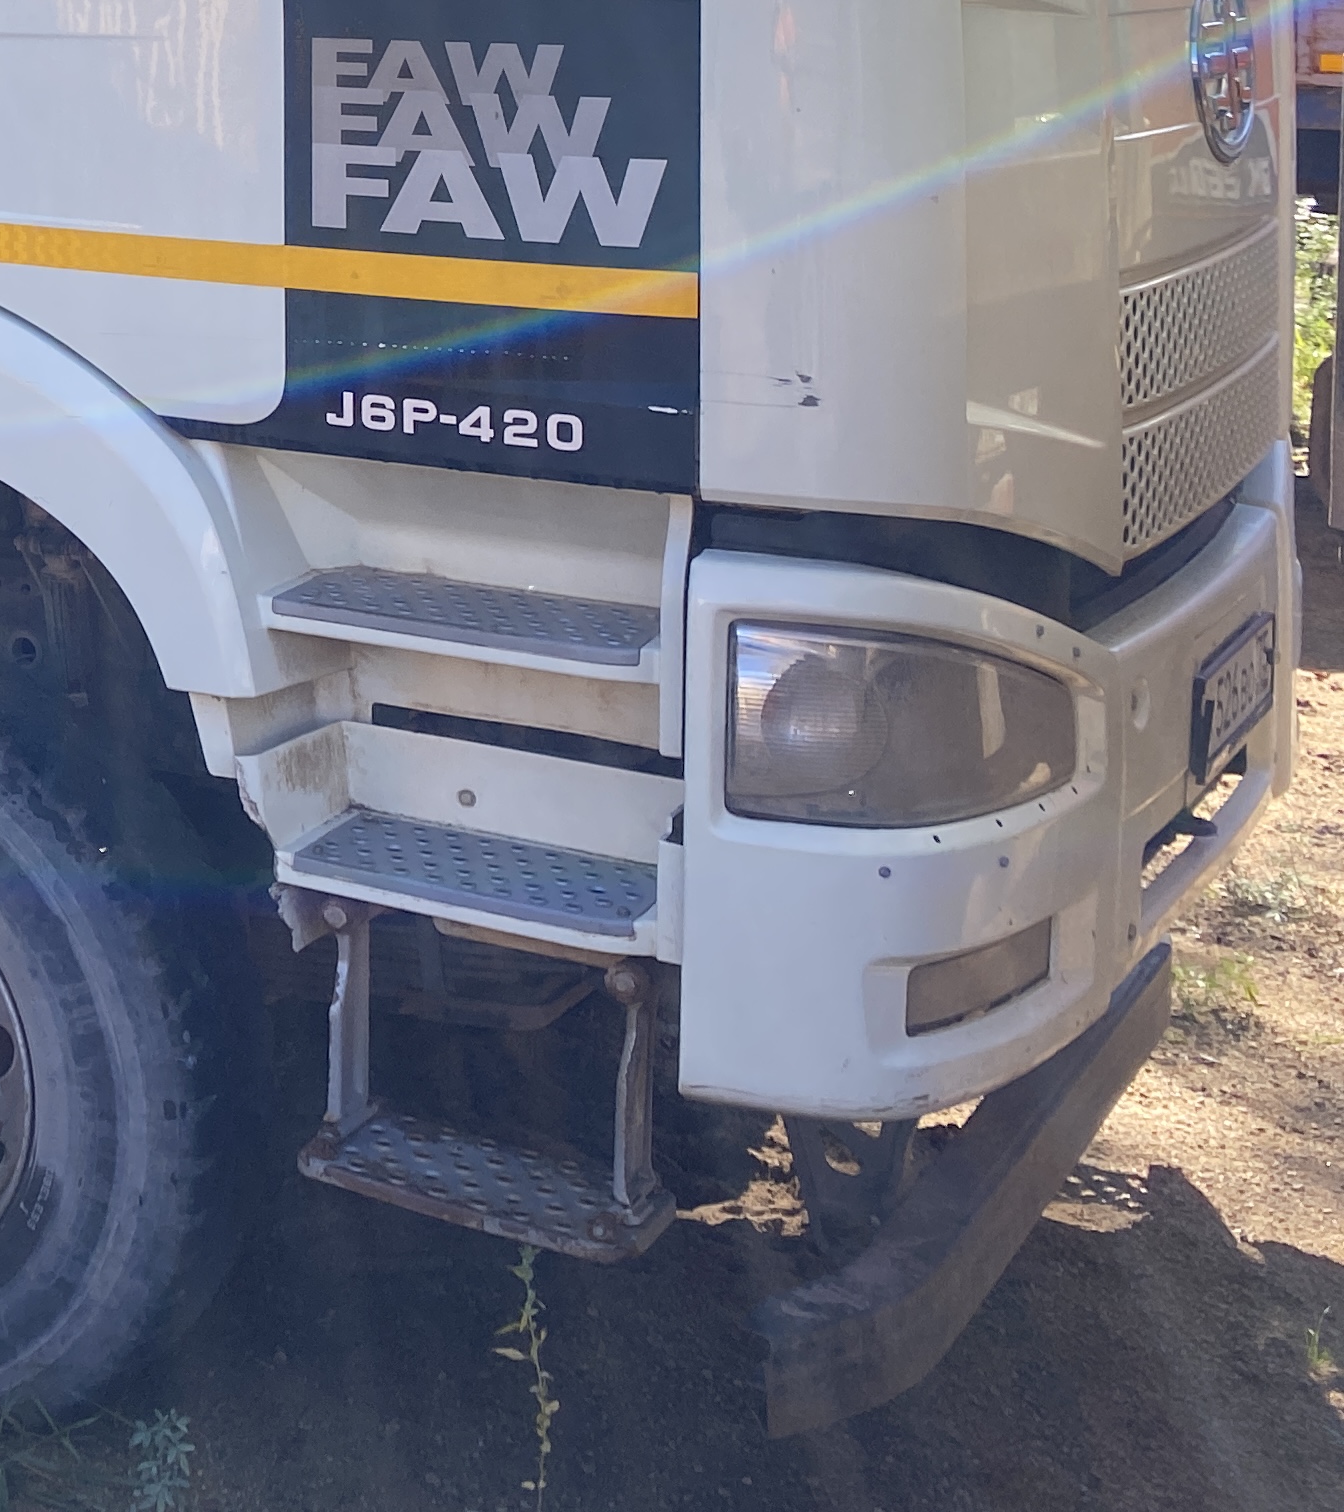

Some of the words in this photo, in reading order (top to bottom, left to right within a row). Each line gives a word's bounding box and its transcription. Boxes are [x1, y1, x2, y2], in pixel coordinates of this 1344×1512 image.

[312, 37, 564, 106] FAW
[312, 87, 611, 168] FAW
[312, 143, 668, 248] FAW
[325, 391, 584, 452] J6P-420
